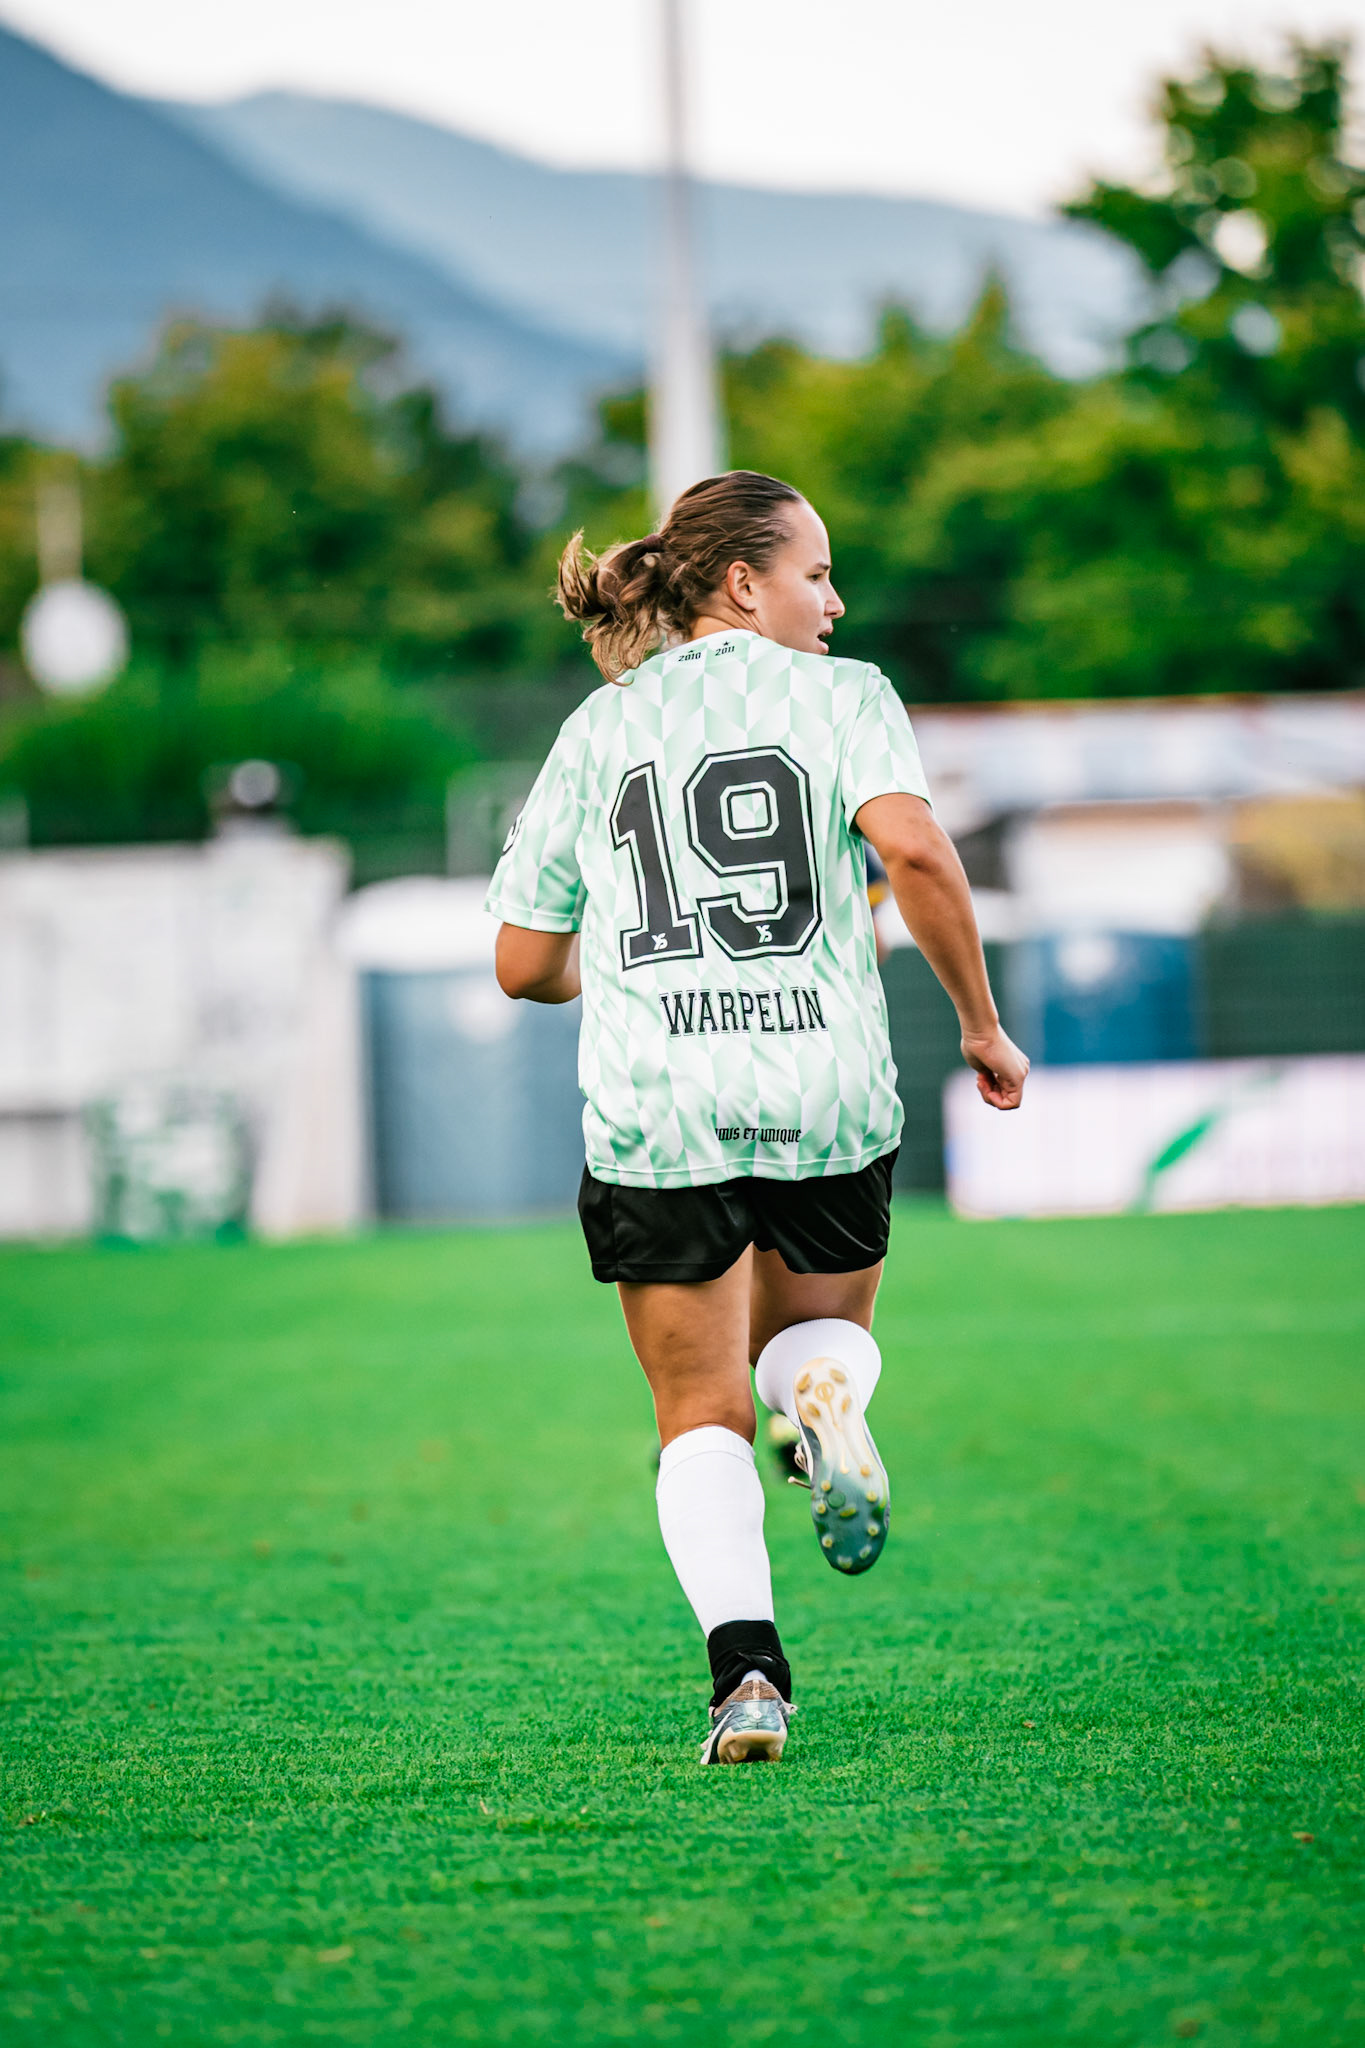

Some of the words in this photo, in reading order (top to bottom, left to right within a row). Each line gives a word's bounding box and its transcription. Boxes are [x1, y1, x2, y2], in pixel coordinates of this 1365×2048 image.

[678, 652, 702, 662] 2010
[714, 645, 735, 657] 2011
[609, 745, 823, 972] 19
[658, 986, 828, 1038] WARPELIN
[743, 1127, 759, 1141] ET
[760, 1128, 802, 1145] UNIQUE
